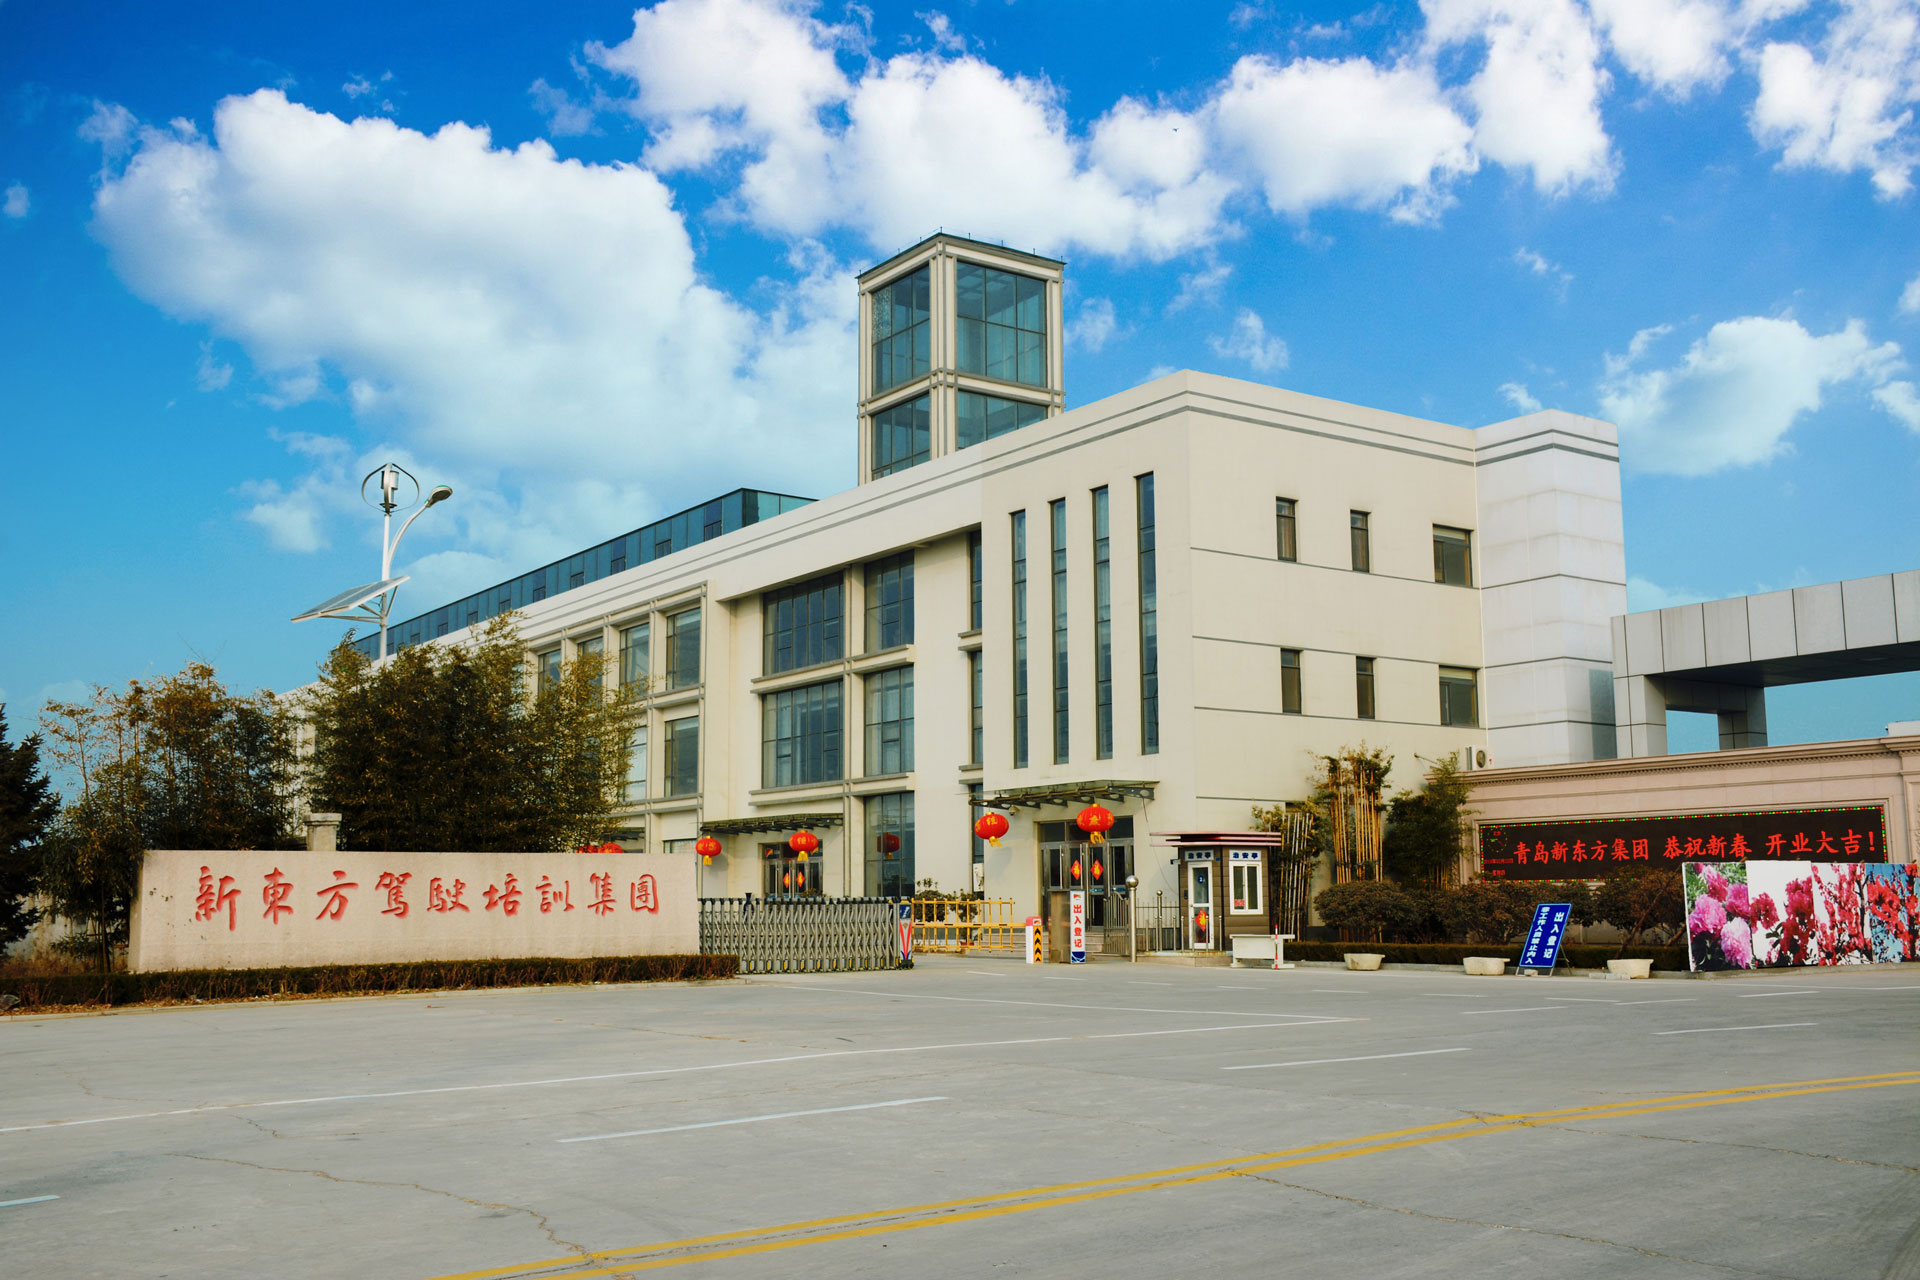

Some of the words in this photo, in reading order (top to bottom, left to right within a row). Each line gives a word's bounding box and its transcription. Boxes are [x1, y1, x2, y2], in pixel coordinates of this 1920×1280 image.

[1513, 838, 1650, 865] 青岛新东方集团
[1662, 832, 1753, 859] 恭祝新春
[1764, 827, 1876, 857] 开业大吉!
[1073, 904, 1083, 949] 出入登记
[1543, 911, 1565, 959] 出入登记
